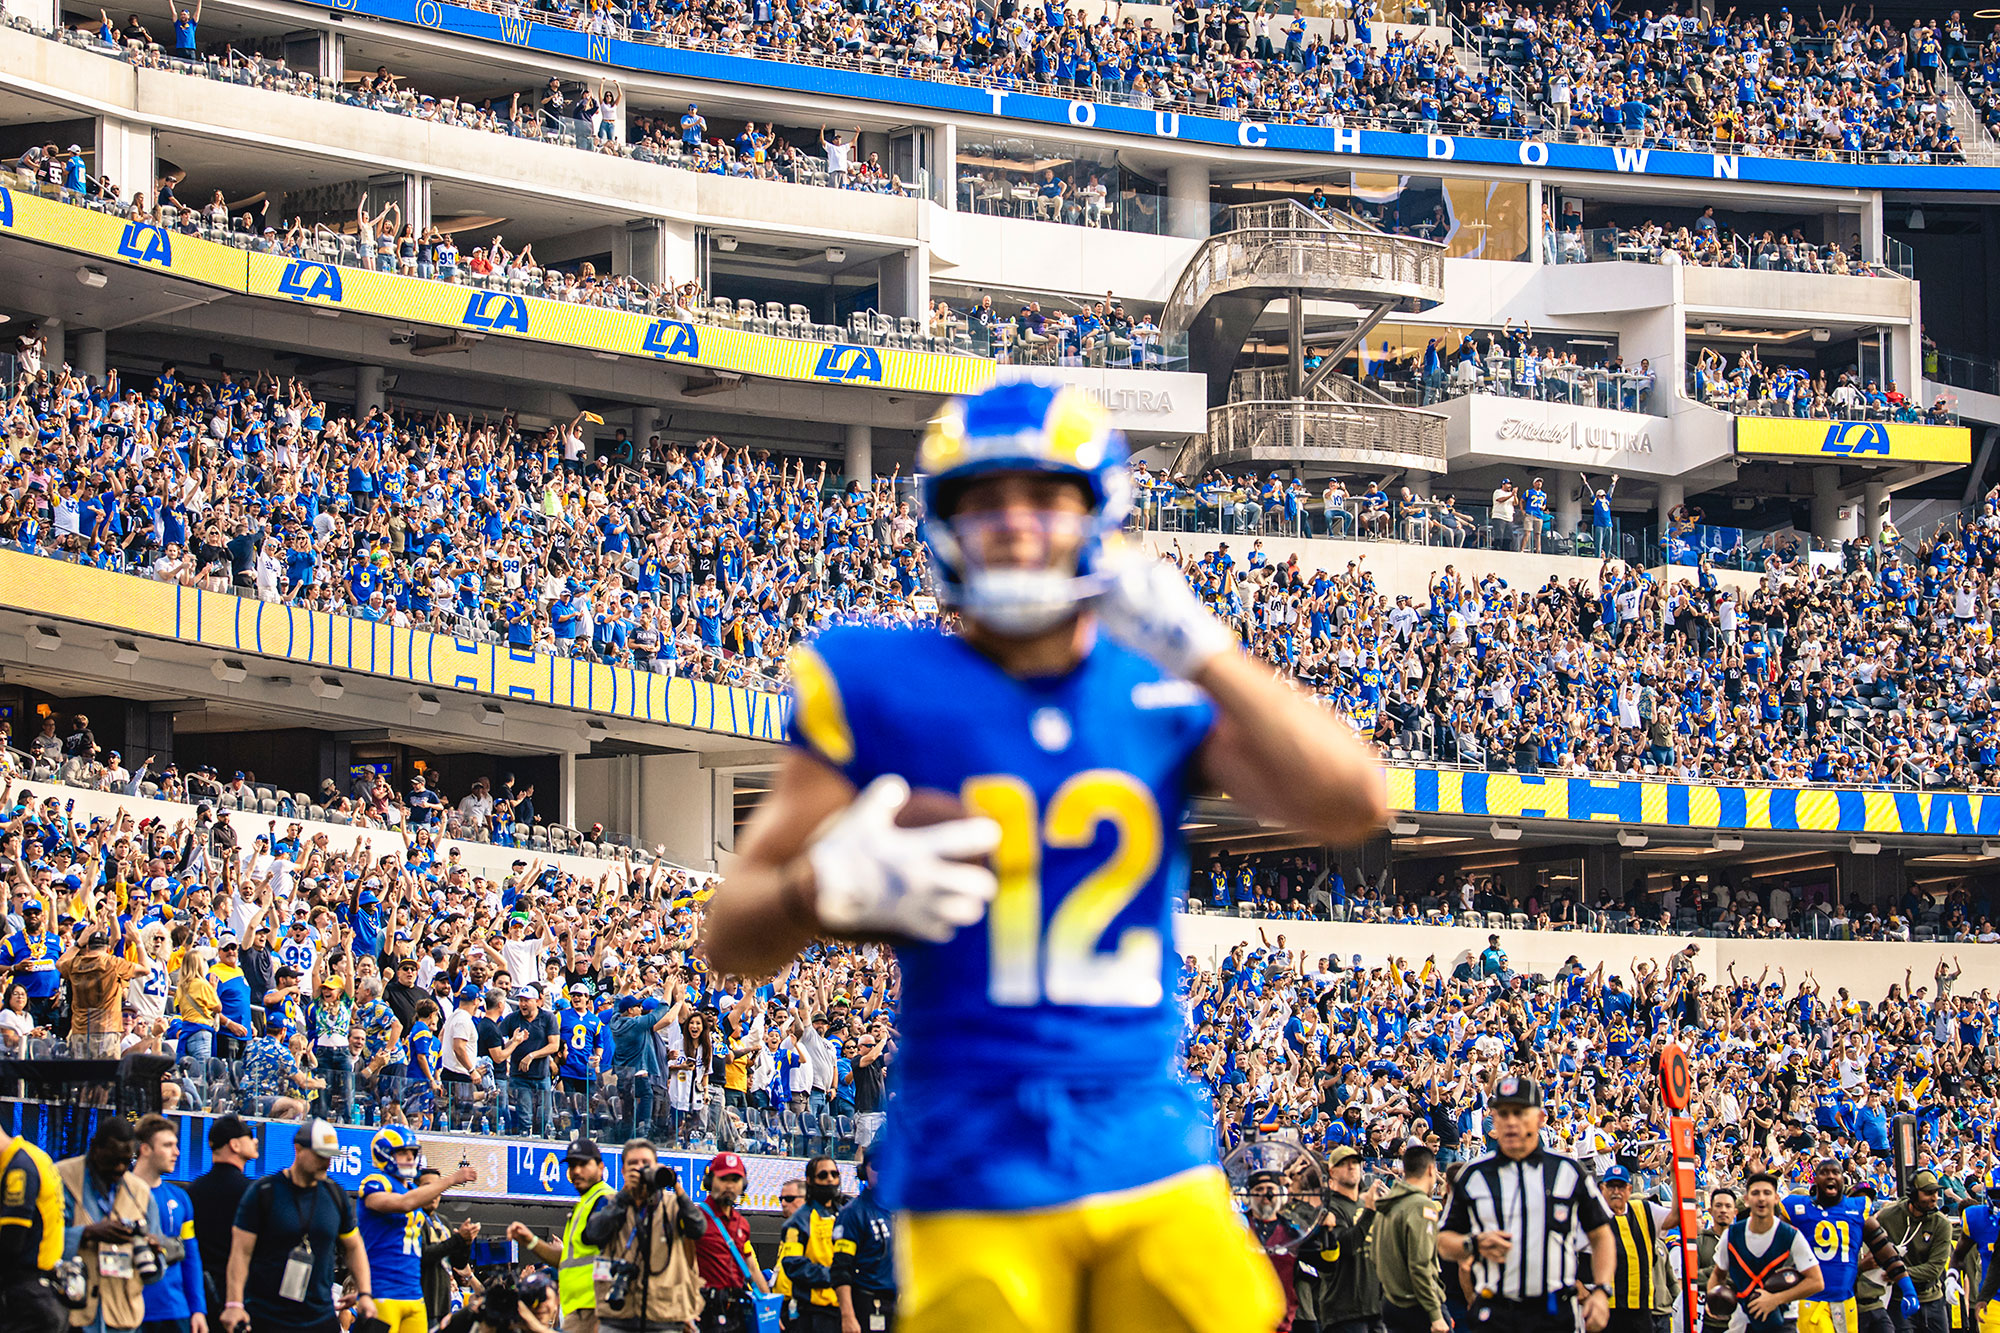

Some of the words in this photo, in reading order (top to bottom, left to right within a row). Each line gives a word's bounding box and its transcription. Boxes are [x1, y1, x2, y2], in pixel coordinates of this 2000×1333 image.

[1683, 20, 1696, 31] 99
[1923, 44, 1936, 54] 30
[1746, 53, 1757, 64] 99
[985, 89, 1740, 179] TOUCHDOWN
[50, 168, 62, 184] 95
[117, 219, 172, 266] LA
[440, 251, 455, 266] 99
[278, 259, 343, 304] LA
[462, 290, 529, 333] LA
[981, 313, 989, 326] 9
[642, 319, 699, 359] LA
[814, 343, 882, 383] LA
[163, 384, 173, 397] 17
[221, 387, 233, 401] 12
[1585, 425, 1653, 453] ULTRA
[1821, 421, 1890, 457] LA
[137, 447, 148, 457] 12
[1332, 494, 1342, 506] 10
[1531, 496, 1544, 508] 23
[803, 517, 810, 529] 9
[555, 532, 565, 547] 12
[503, 560, 519, 573] 99
[701, 559, 711, 570] 12
[723, 554, 731, 567] 9
[645, 564, 656, 578] 10
[361, 572, 371, 588] 8
[1626, 598, 1636, 609] 17
[1862, 594, 1870, 604] 9
[1467, 601, 1476, 613] 10
[1363, 674, 1379, 686] 99
[1730, 668, 1739, 679] 12
[1791, 679, 1802, 691] 12
[960, 767, 1164, 1008] 12
[1216, 877, 1226, 890] 12
[284, 944, 311, 970] 99
[143, 967, 168, 998] 23
[571, 1024, 587, 1050] 8
[1610, 1028, 1627, 1043] 29
[1621, 1138, 1639, 1157] 23
[516, 1146, 534, 1175] 14
[487, 1152, 499, 1187] 3
[1813, 1220, 1850, 1263] 91
